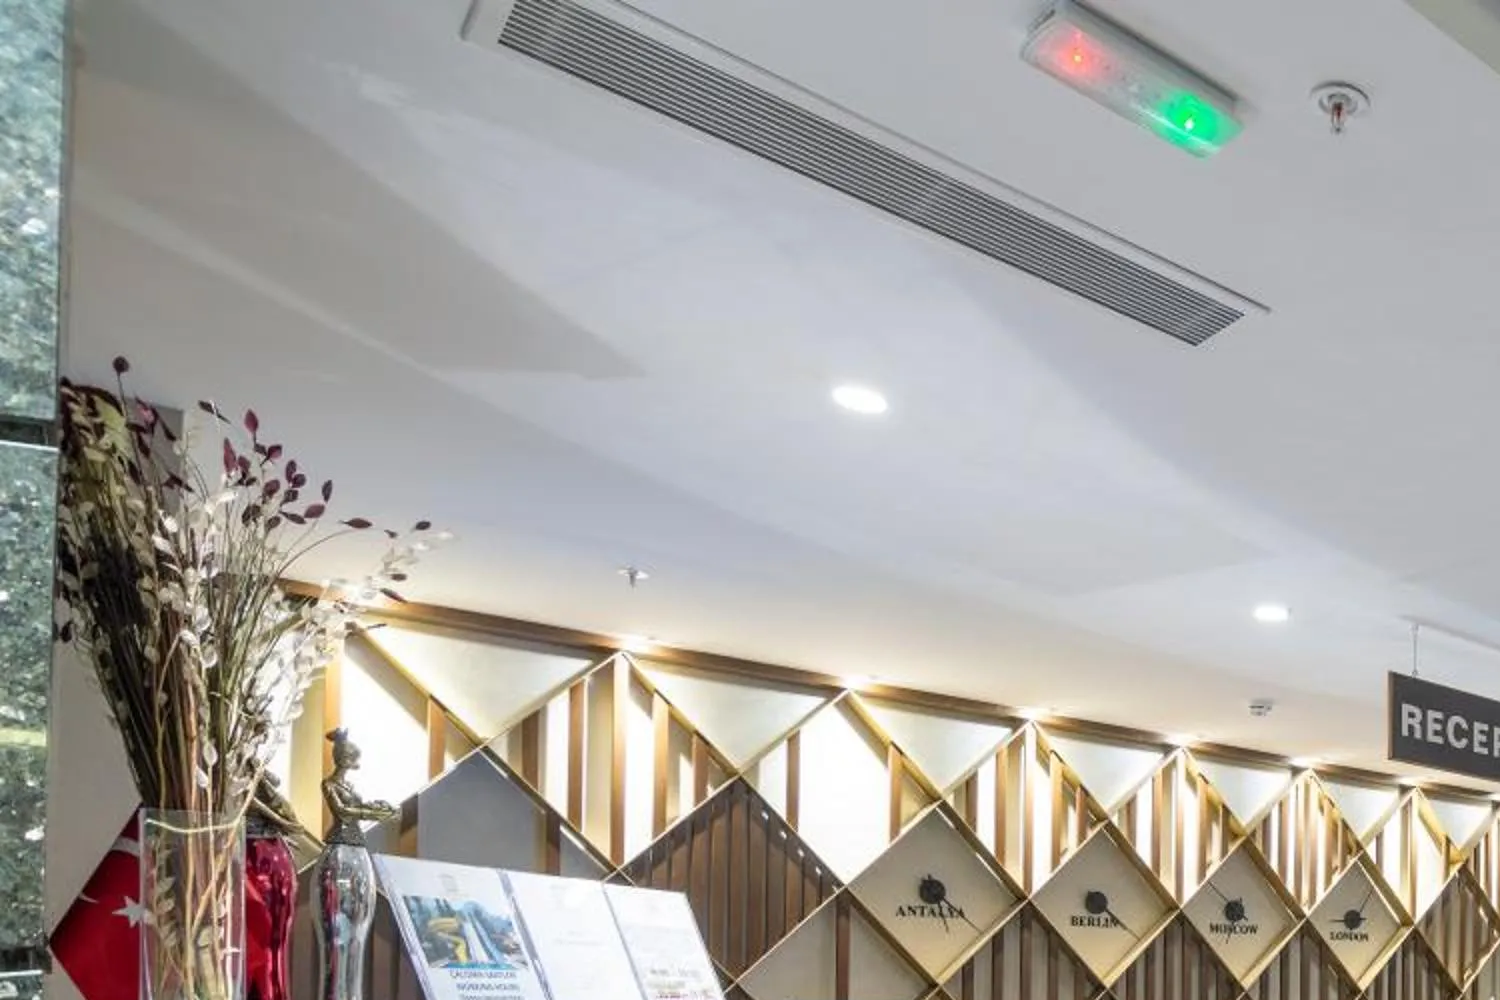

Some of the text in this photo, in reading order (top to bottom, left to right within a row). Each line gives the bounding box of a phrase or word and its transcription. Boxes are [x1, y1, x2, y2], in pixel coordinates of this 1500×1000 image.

[1070, 915, 1118, 928] BERLIN
[1209, 922, 1258, 935] MOSCOW
[1330, 931, 1369, 942] LONDON
